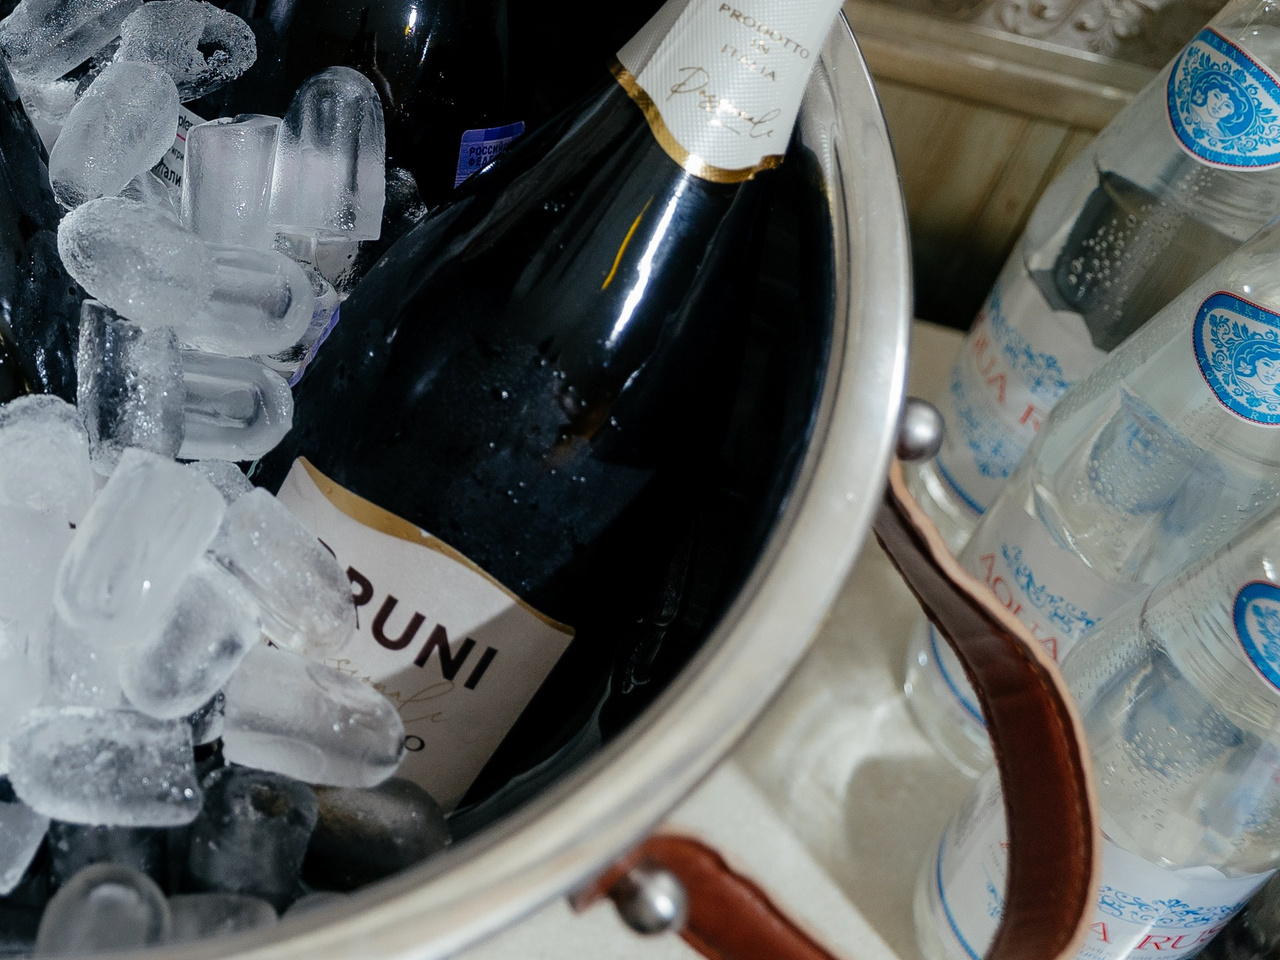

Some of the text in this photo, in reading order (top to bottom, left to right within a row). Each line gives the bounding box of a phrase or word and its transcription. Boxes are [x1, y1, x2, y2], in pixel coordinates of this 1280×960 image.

[718, 2, 810, 60] PRODOTTO
[720, 43, 776, 82] ITALIA
[317, 536, 499, 690] RUNI
